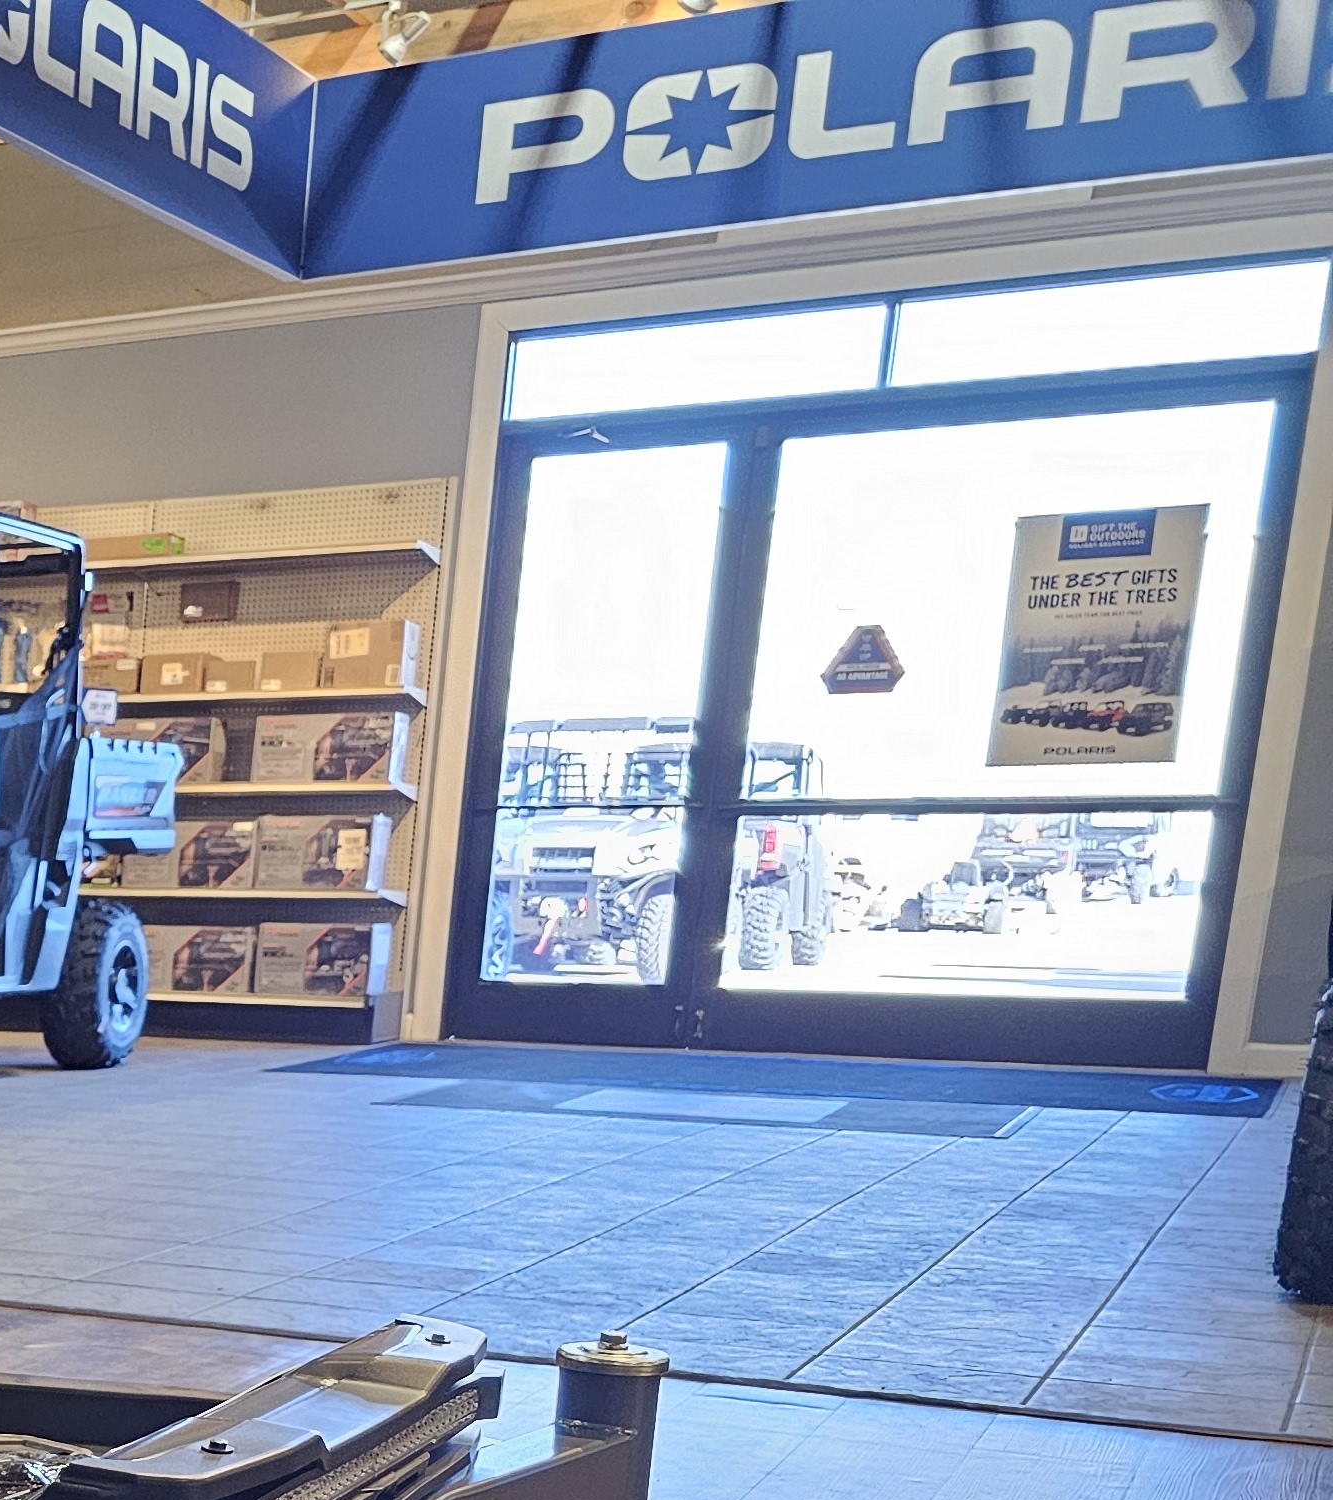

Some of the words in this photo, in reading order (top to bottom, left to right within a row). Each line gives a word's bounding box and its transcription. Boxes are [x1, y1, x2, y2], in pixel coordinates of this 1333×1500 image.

[475, 0, 1333, 205] POLARI
[1030, 574, 1060, 591] THE
[1065, 570, 1130, 588] BEST
[1131, 568, 1178, 585] GIFTS
[1028, 592, 1081, 609] UNDER
[1088, 590, 1119, 606] THE
[1125, 587, 1178, 604] TREES
[1043, 745, 1117, 756] POLARIS
